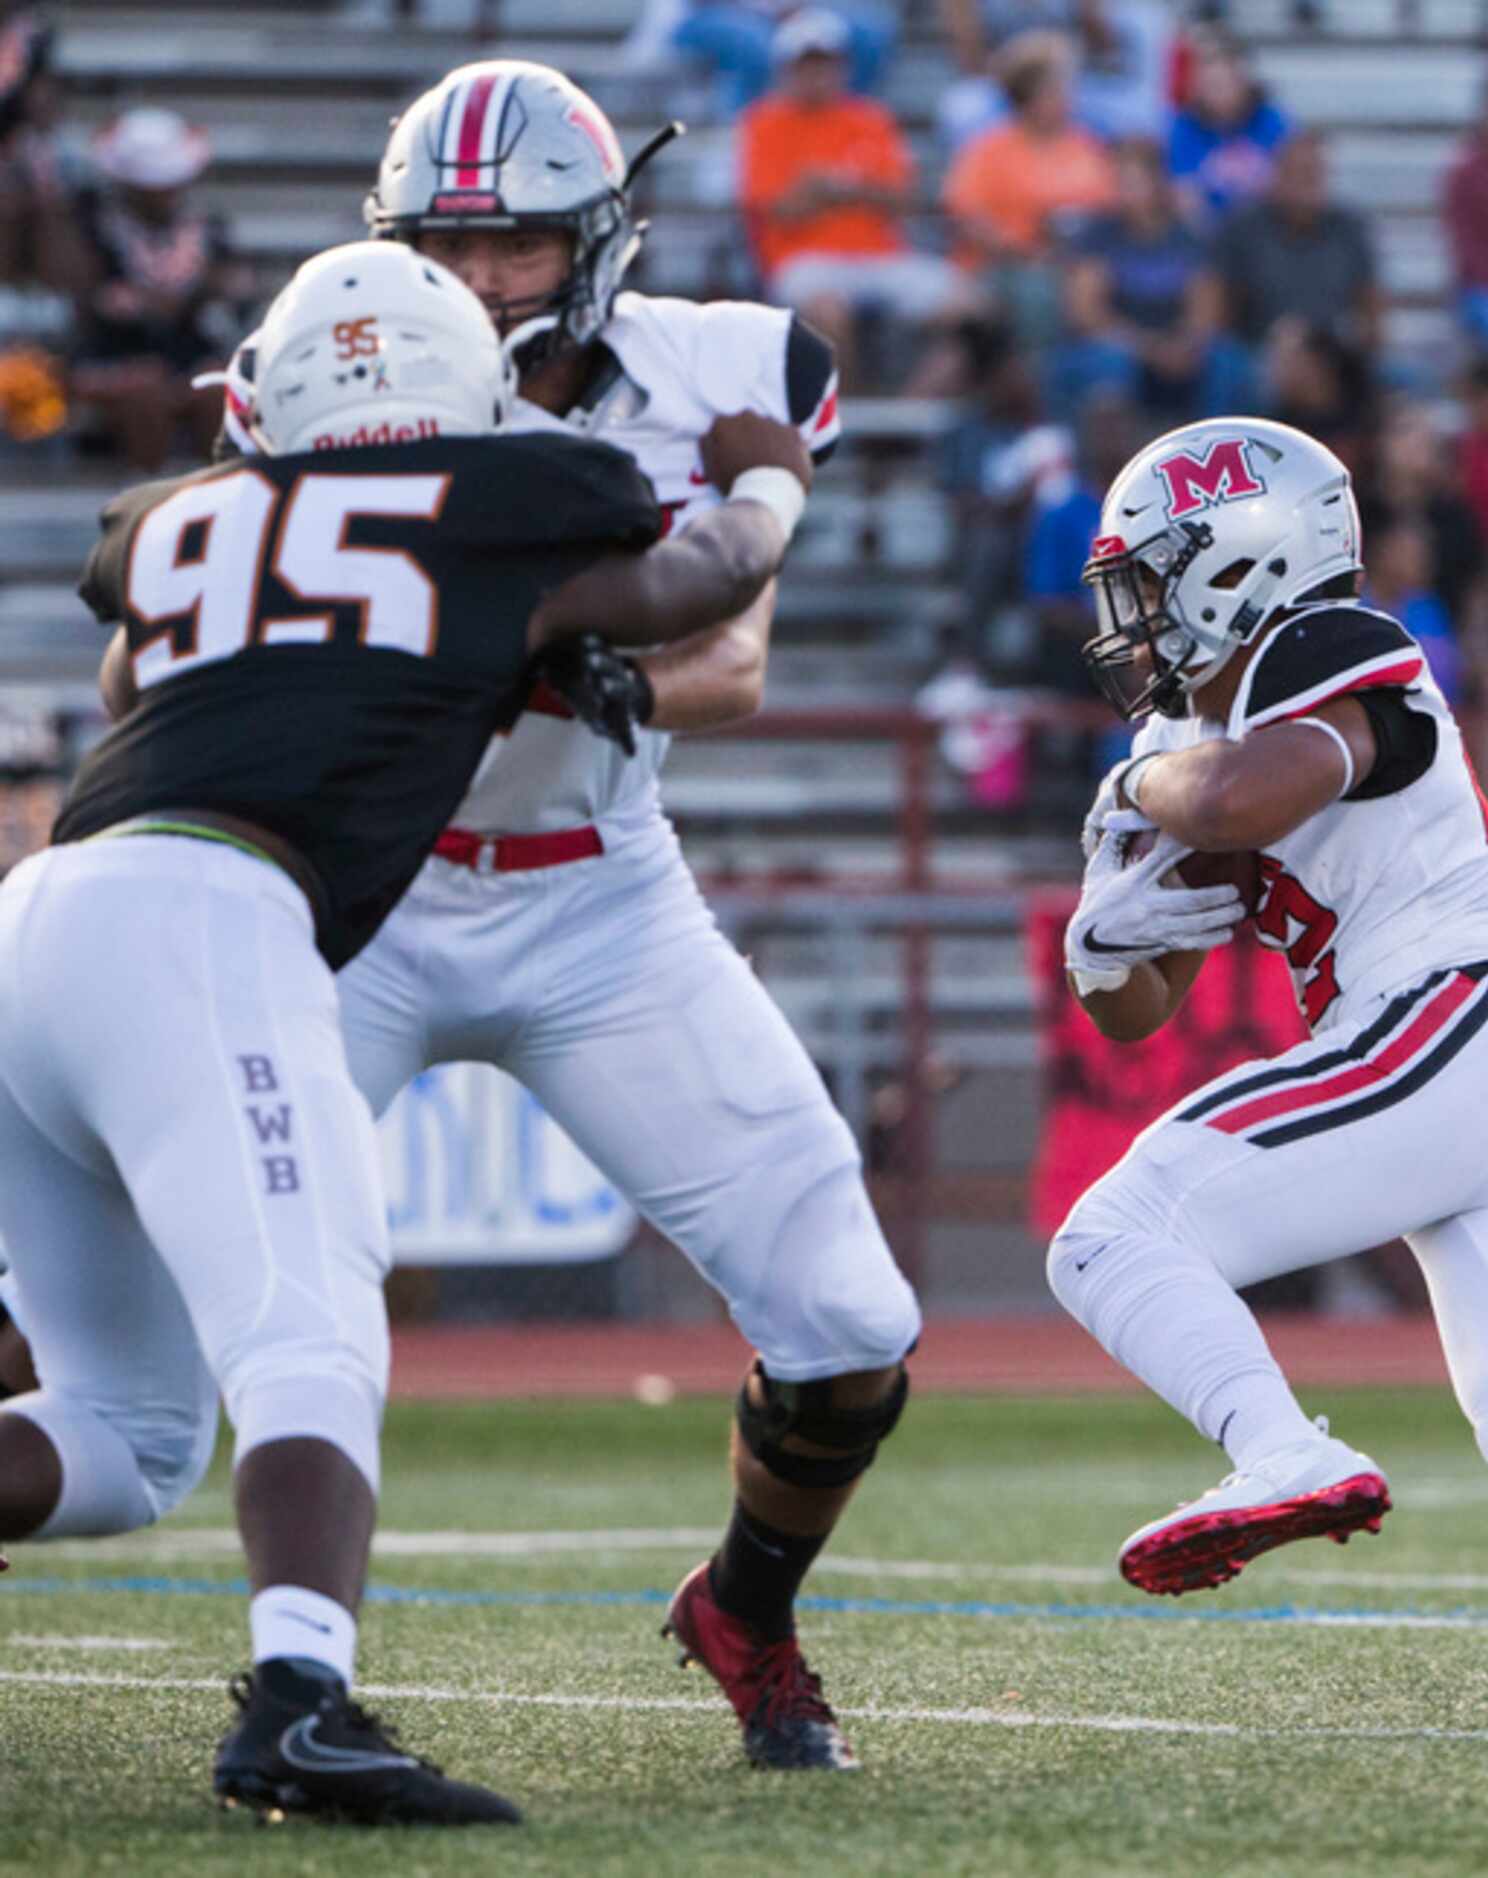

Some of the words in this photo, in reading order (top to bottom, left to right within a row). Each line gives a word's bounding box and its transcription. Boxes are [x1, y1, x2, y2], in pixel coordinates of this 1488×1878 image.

[333, 316, 379, 360] 95
[1153, 437, 1266, 522] M
[127, 468, 453, 690] 95
